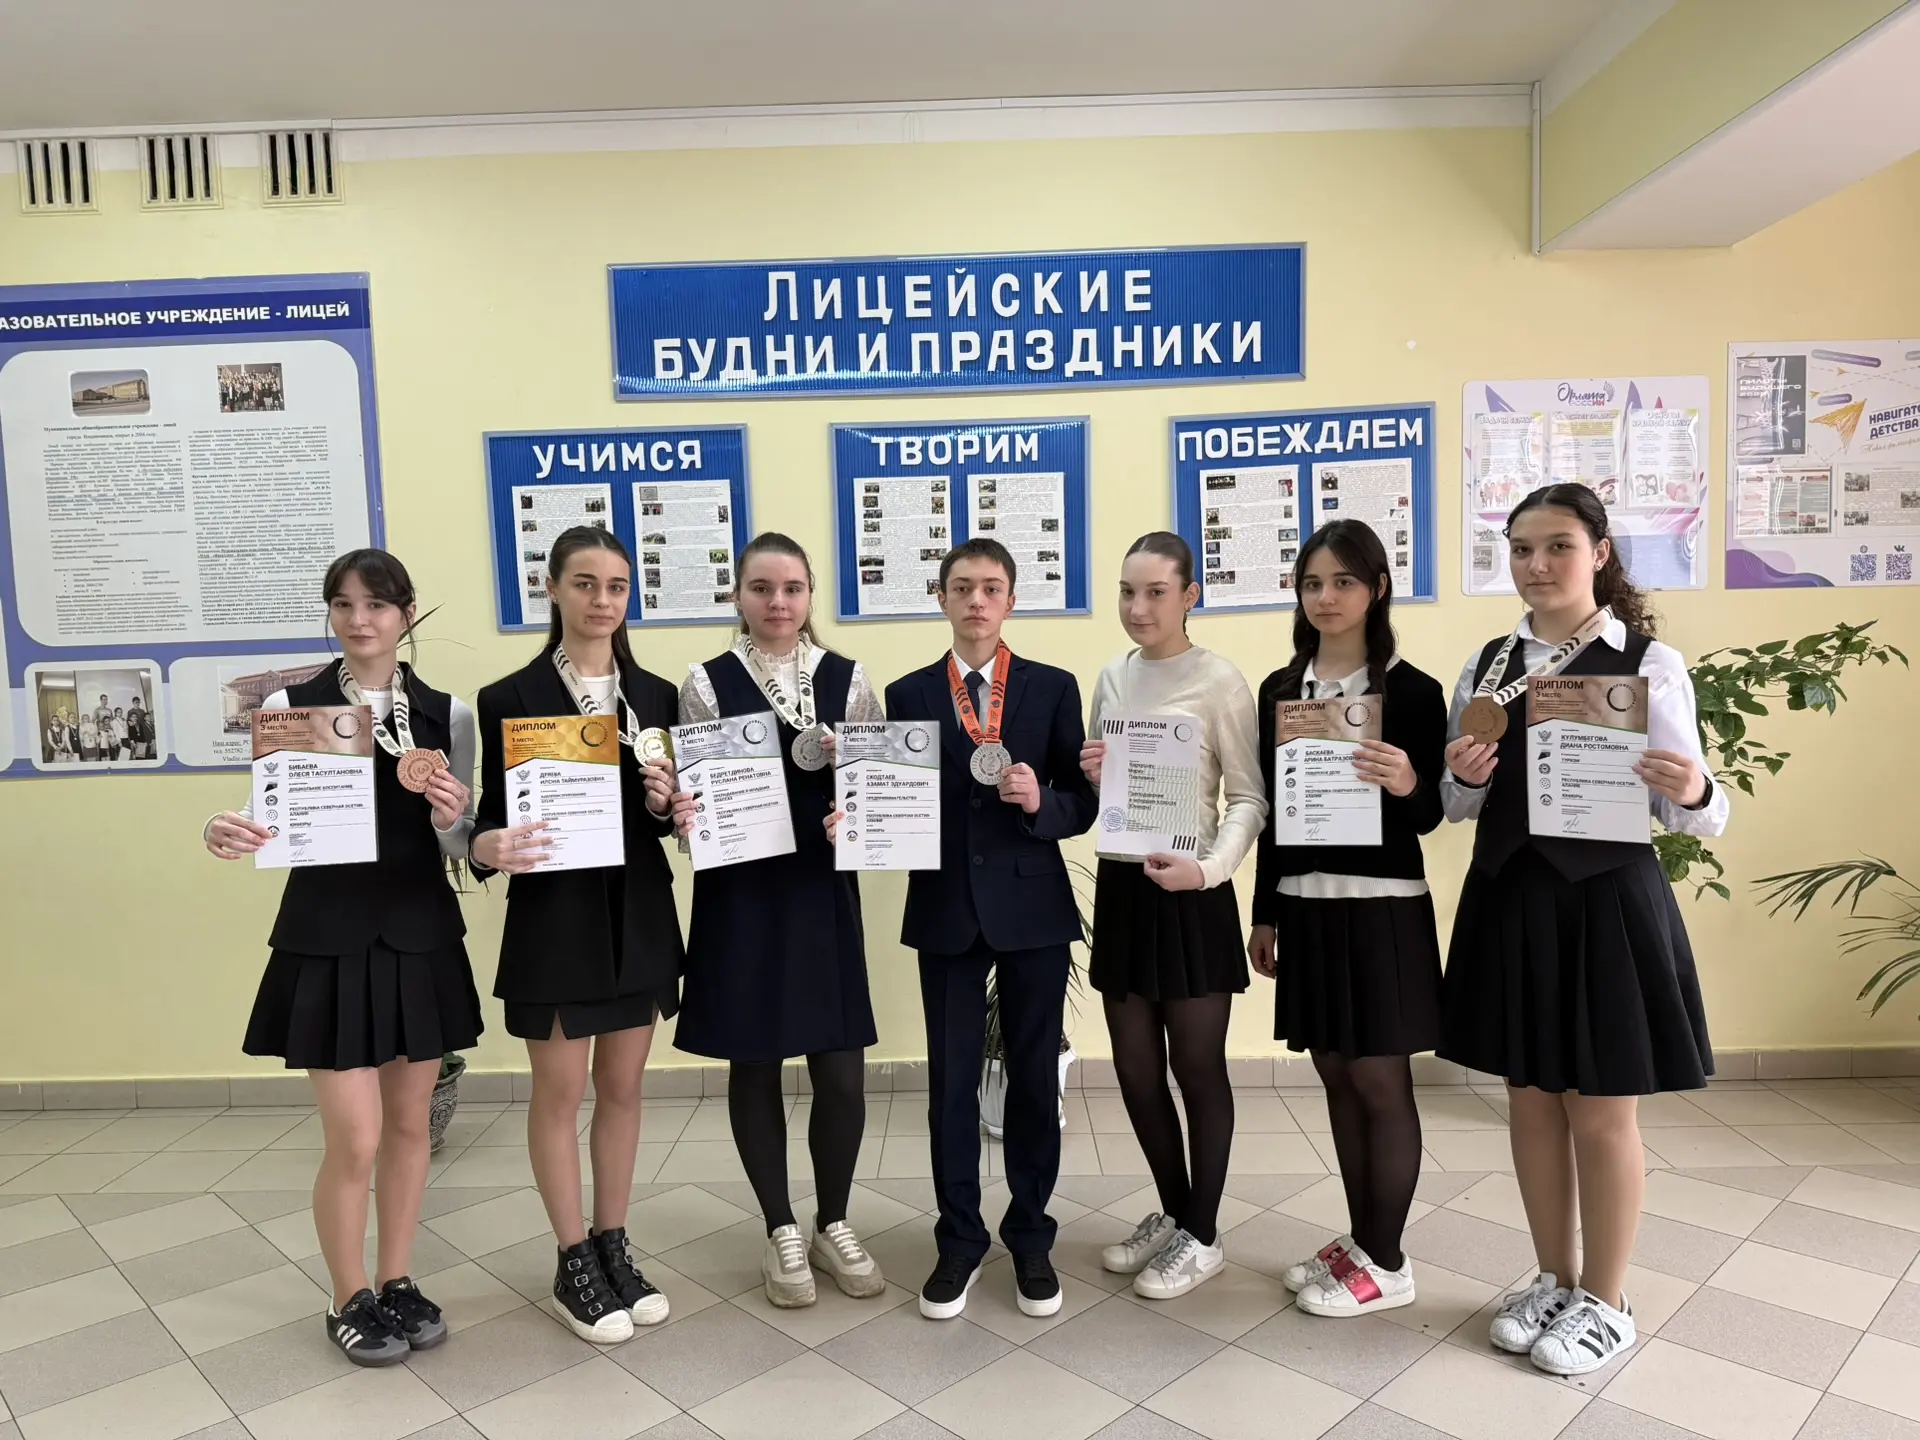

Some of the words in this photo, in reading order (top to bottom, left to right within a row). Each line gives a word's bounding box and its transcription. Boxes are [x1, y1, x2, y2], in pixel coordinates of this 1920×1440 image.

[145, 307, 271, 325] УЧРЕЖДЕНИЕ
[285, 301, 350, 319] ЛИЦЕЙ
[653, 332, 836, 381] БУДНИ
[858, 333, 889, 376] И
[910, 321, 1263, 378] ПРАЗДНИКИ
[1870, 418, 1919, 440] ДЕТСТВА
[1178, 417, 1423, 461] ПОБЕЖДАЕМ
[871, 433, 1039, 466] ТВОРИМ
[532, 440, 703, 479] УЧИМСЯ
[1535, 680, 1584, 690] ДИПЛОМ
[1284, 702, 1326, 714] ДИПЛОМ
[260, 712, 310, 723] ДИПЛОМ
[512, 722, 556, 733] ДИПЛОМ
[678, 722, 722, 738] ДИПЛОМ
[843, 725, 886, 735] ДИПЛОМ
[1128, 720, 1167, 730] ДИПЛОМ
[1584, 743, 1629, 751] РОСТОМОВНА
[311, 769, 363, 777] ТАСУЛТАНОВНА
[711, 777, 738, 785] РУСЛАНА
[738, 770, 771, 781] РЕНАТОВНА
